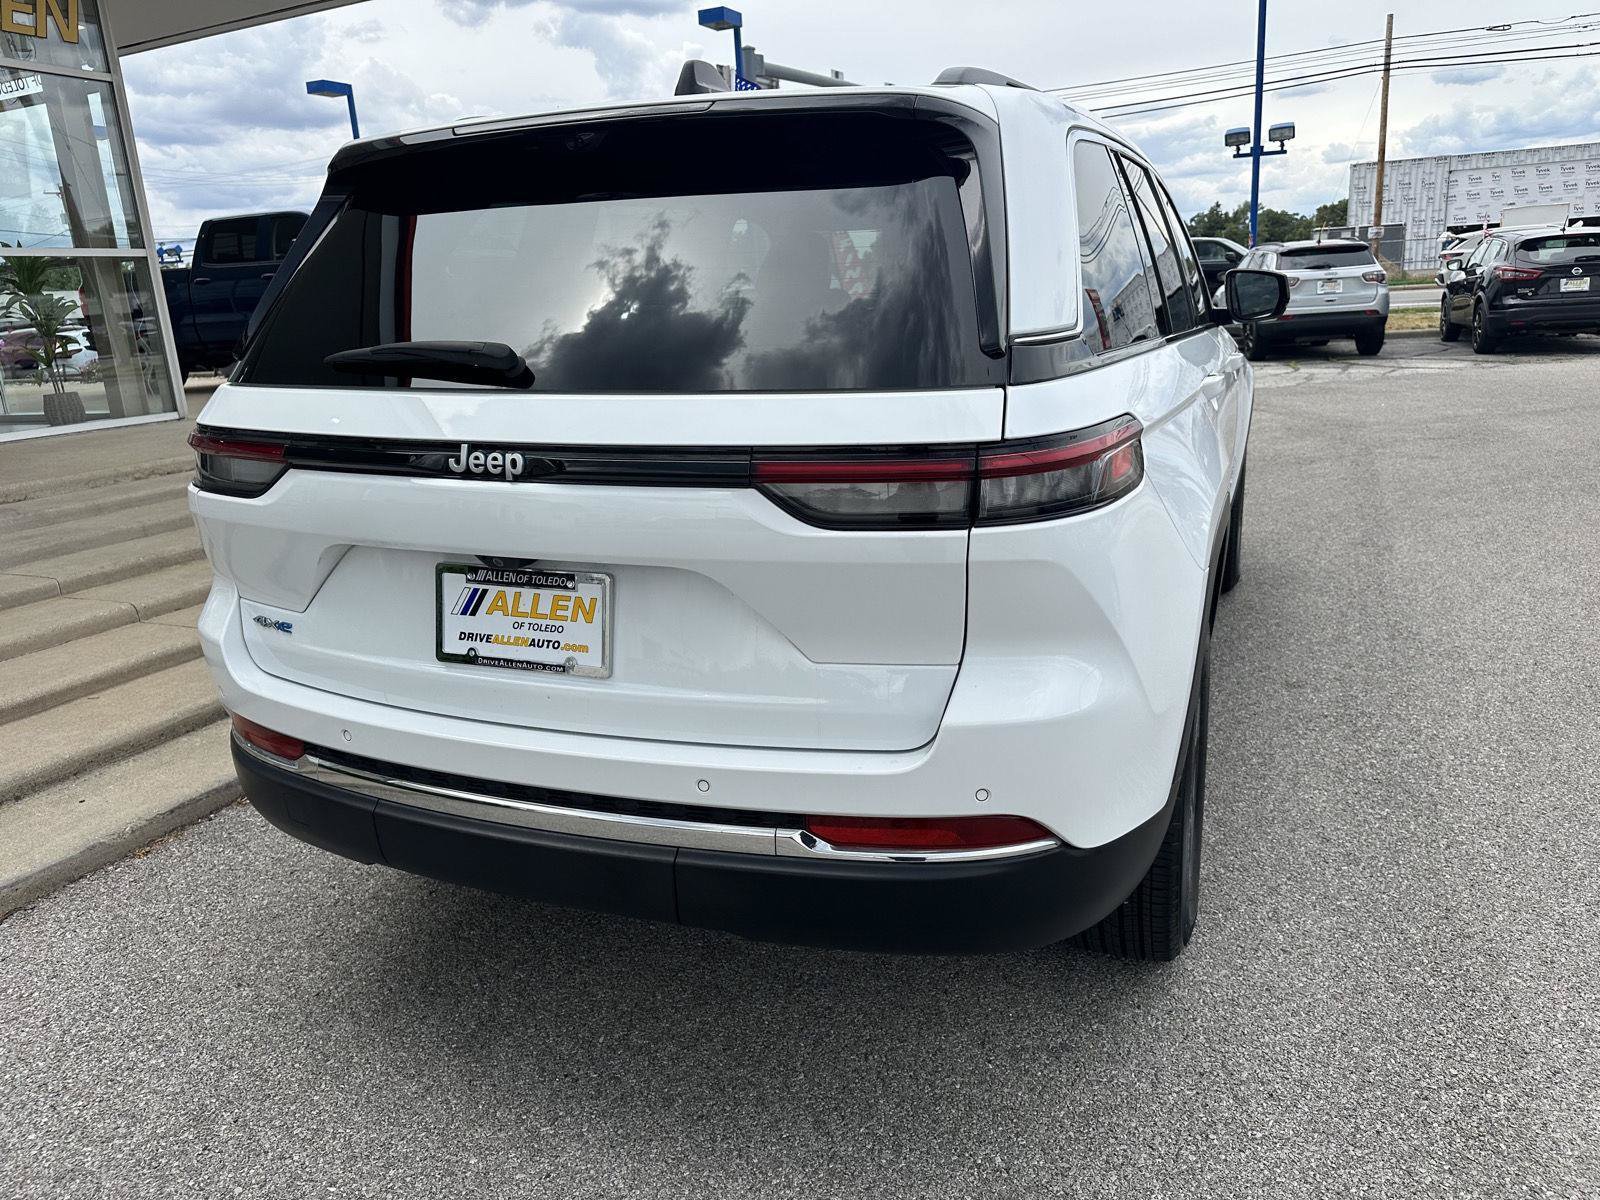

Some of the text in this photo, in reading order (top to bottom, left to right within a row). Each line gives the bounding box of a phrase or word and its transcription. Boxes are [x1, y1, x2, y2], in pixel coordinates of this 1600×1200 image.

[448, 443, 523, 481] Jeep
[485, 570, 567, 586] ALLEN OF TOLEDO
[486, 590, 598, 624] ALLEN
[512, 621, 564, 634] OF TOLEDO
[458, 631, 589, 653] DRIVEALLENAUTO.com
